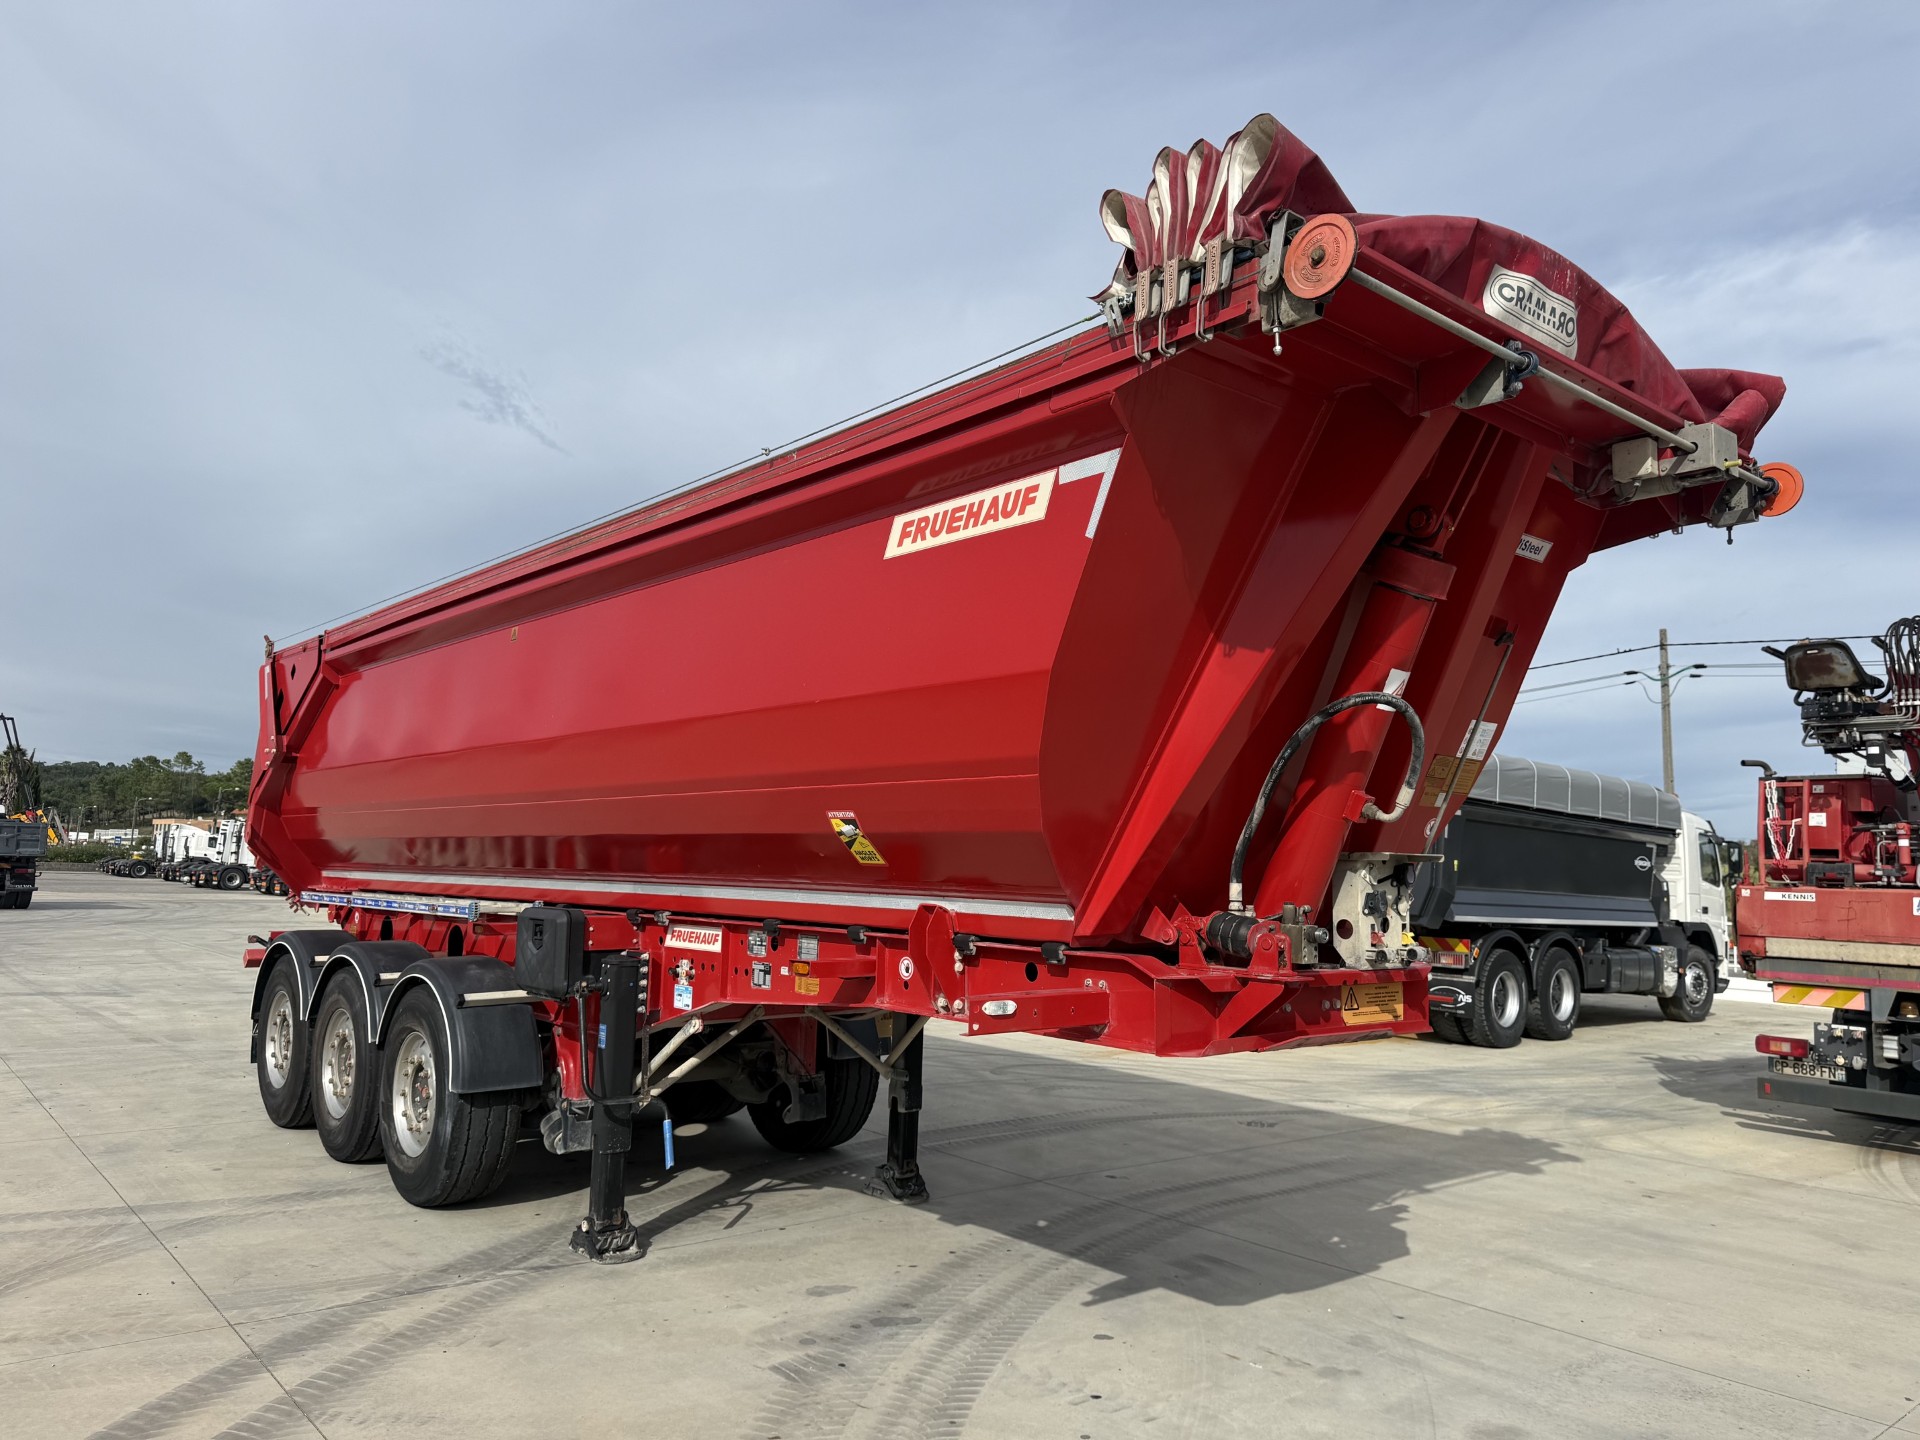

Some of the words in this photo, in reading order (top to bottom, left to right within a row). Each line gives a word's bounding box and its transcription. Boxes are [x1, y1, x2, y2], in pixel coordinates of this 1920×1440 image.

[1498, 283, 1575, 338] CRAMARO
[897, 483, 1040, 547] FRUEHAUF
[1519, 539, 1544, 555] iSteel
[670, 929, 720, 945] FRUEHAUF
